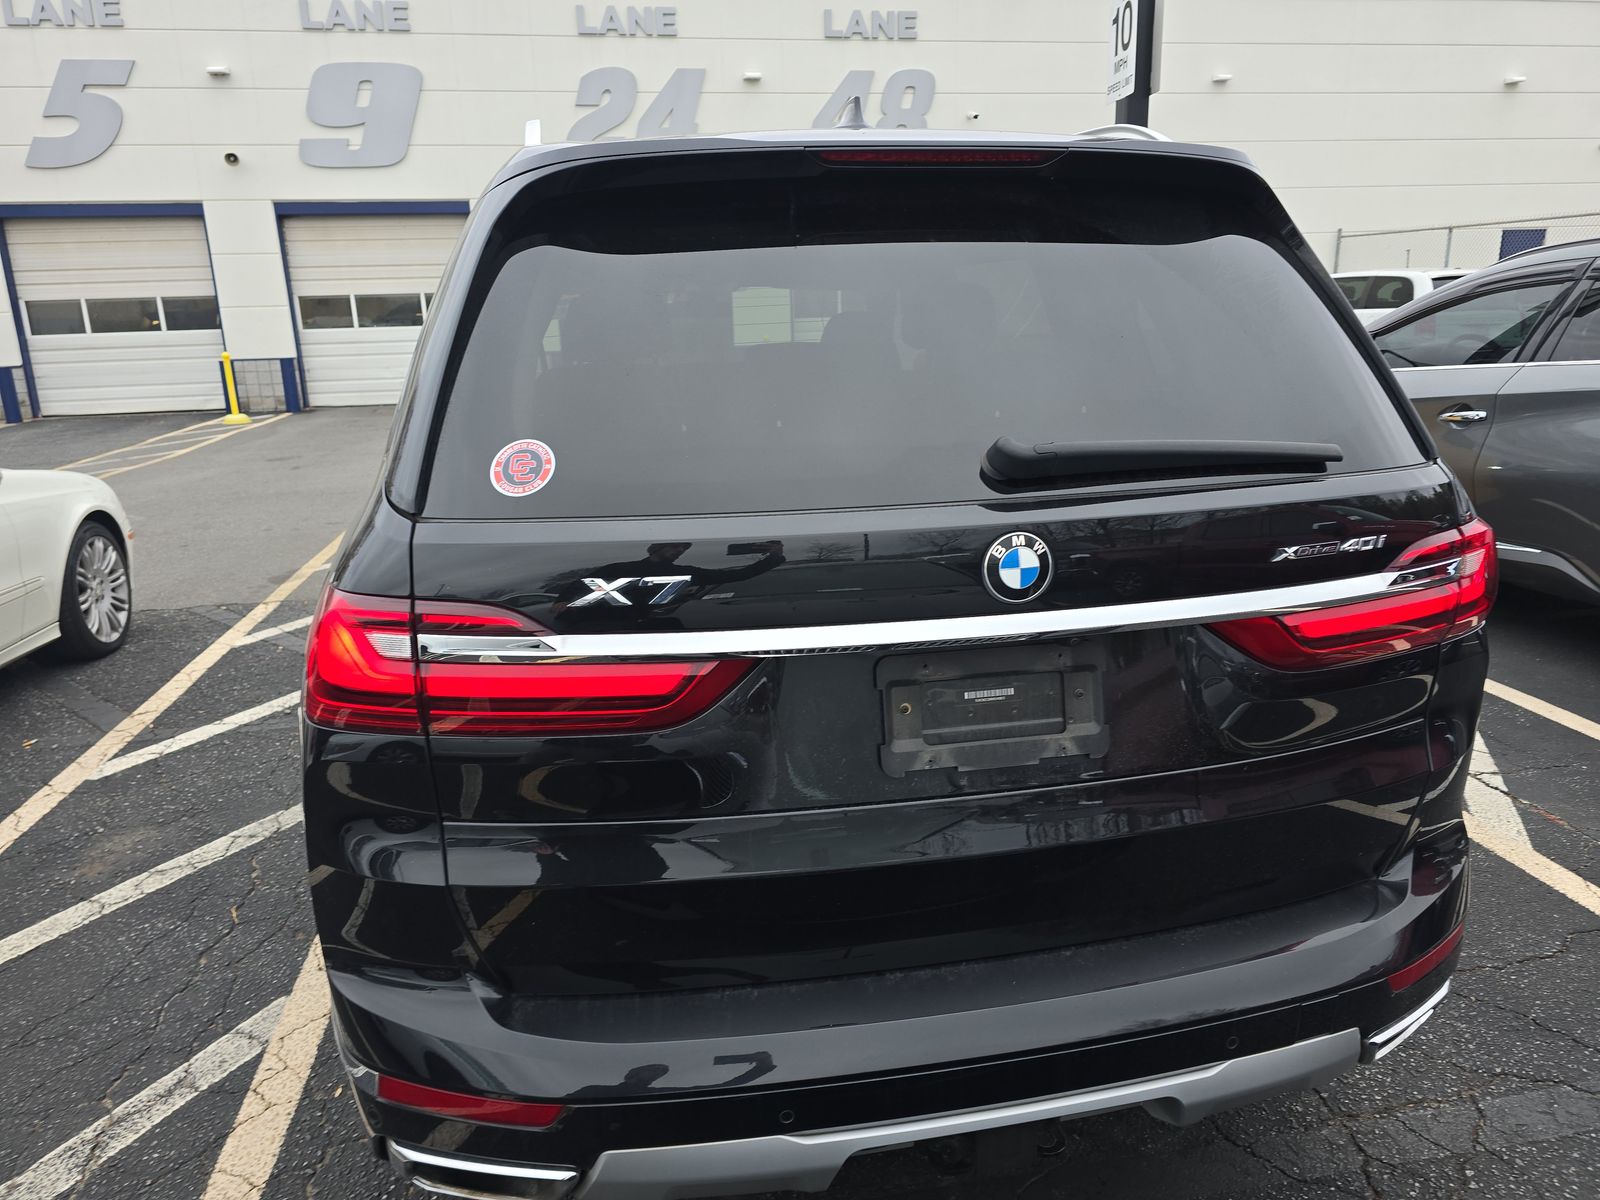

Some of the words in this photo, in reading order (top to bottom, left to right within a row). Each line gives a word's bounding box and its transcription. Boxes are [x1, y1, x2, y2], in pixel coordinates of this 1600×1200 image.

[2, 0, 124, 27] LANE
[300, 0, 411, 31] LANE
[575, 5, 678, 37] LANE
[824, 9, 918, 40] LANE
[1112, 0, 1133, 57] 10
[1113, 55, 1128, 75] MPH
[811, 69, 936, 130] 48
[1106, 80, 1121, 96] SPEED
[1121, 74, 1133, 89] LIMIT
[24, 59, 135, 169] 5
[299, 62, 424, 168] 9
[566, 67, 706, 142] 24
[991, 535, 1047, 559] BMW
[566, 575, 692, 607] X7
